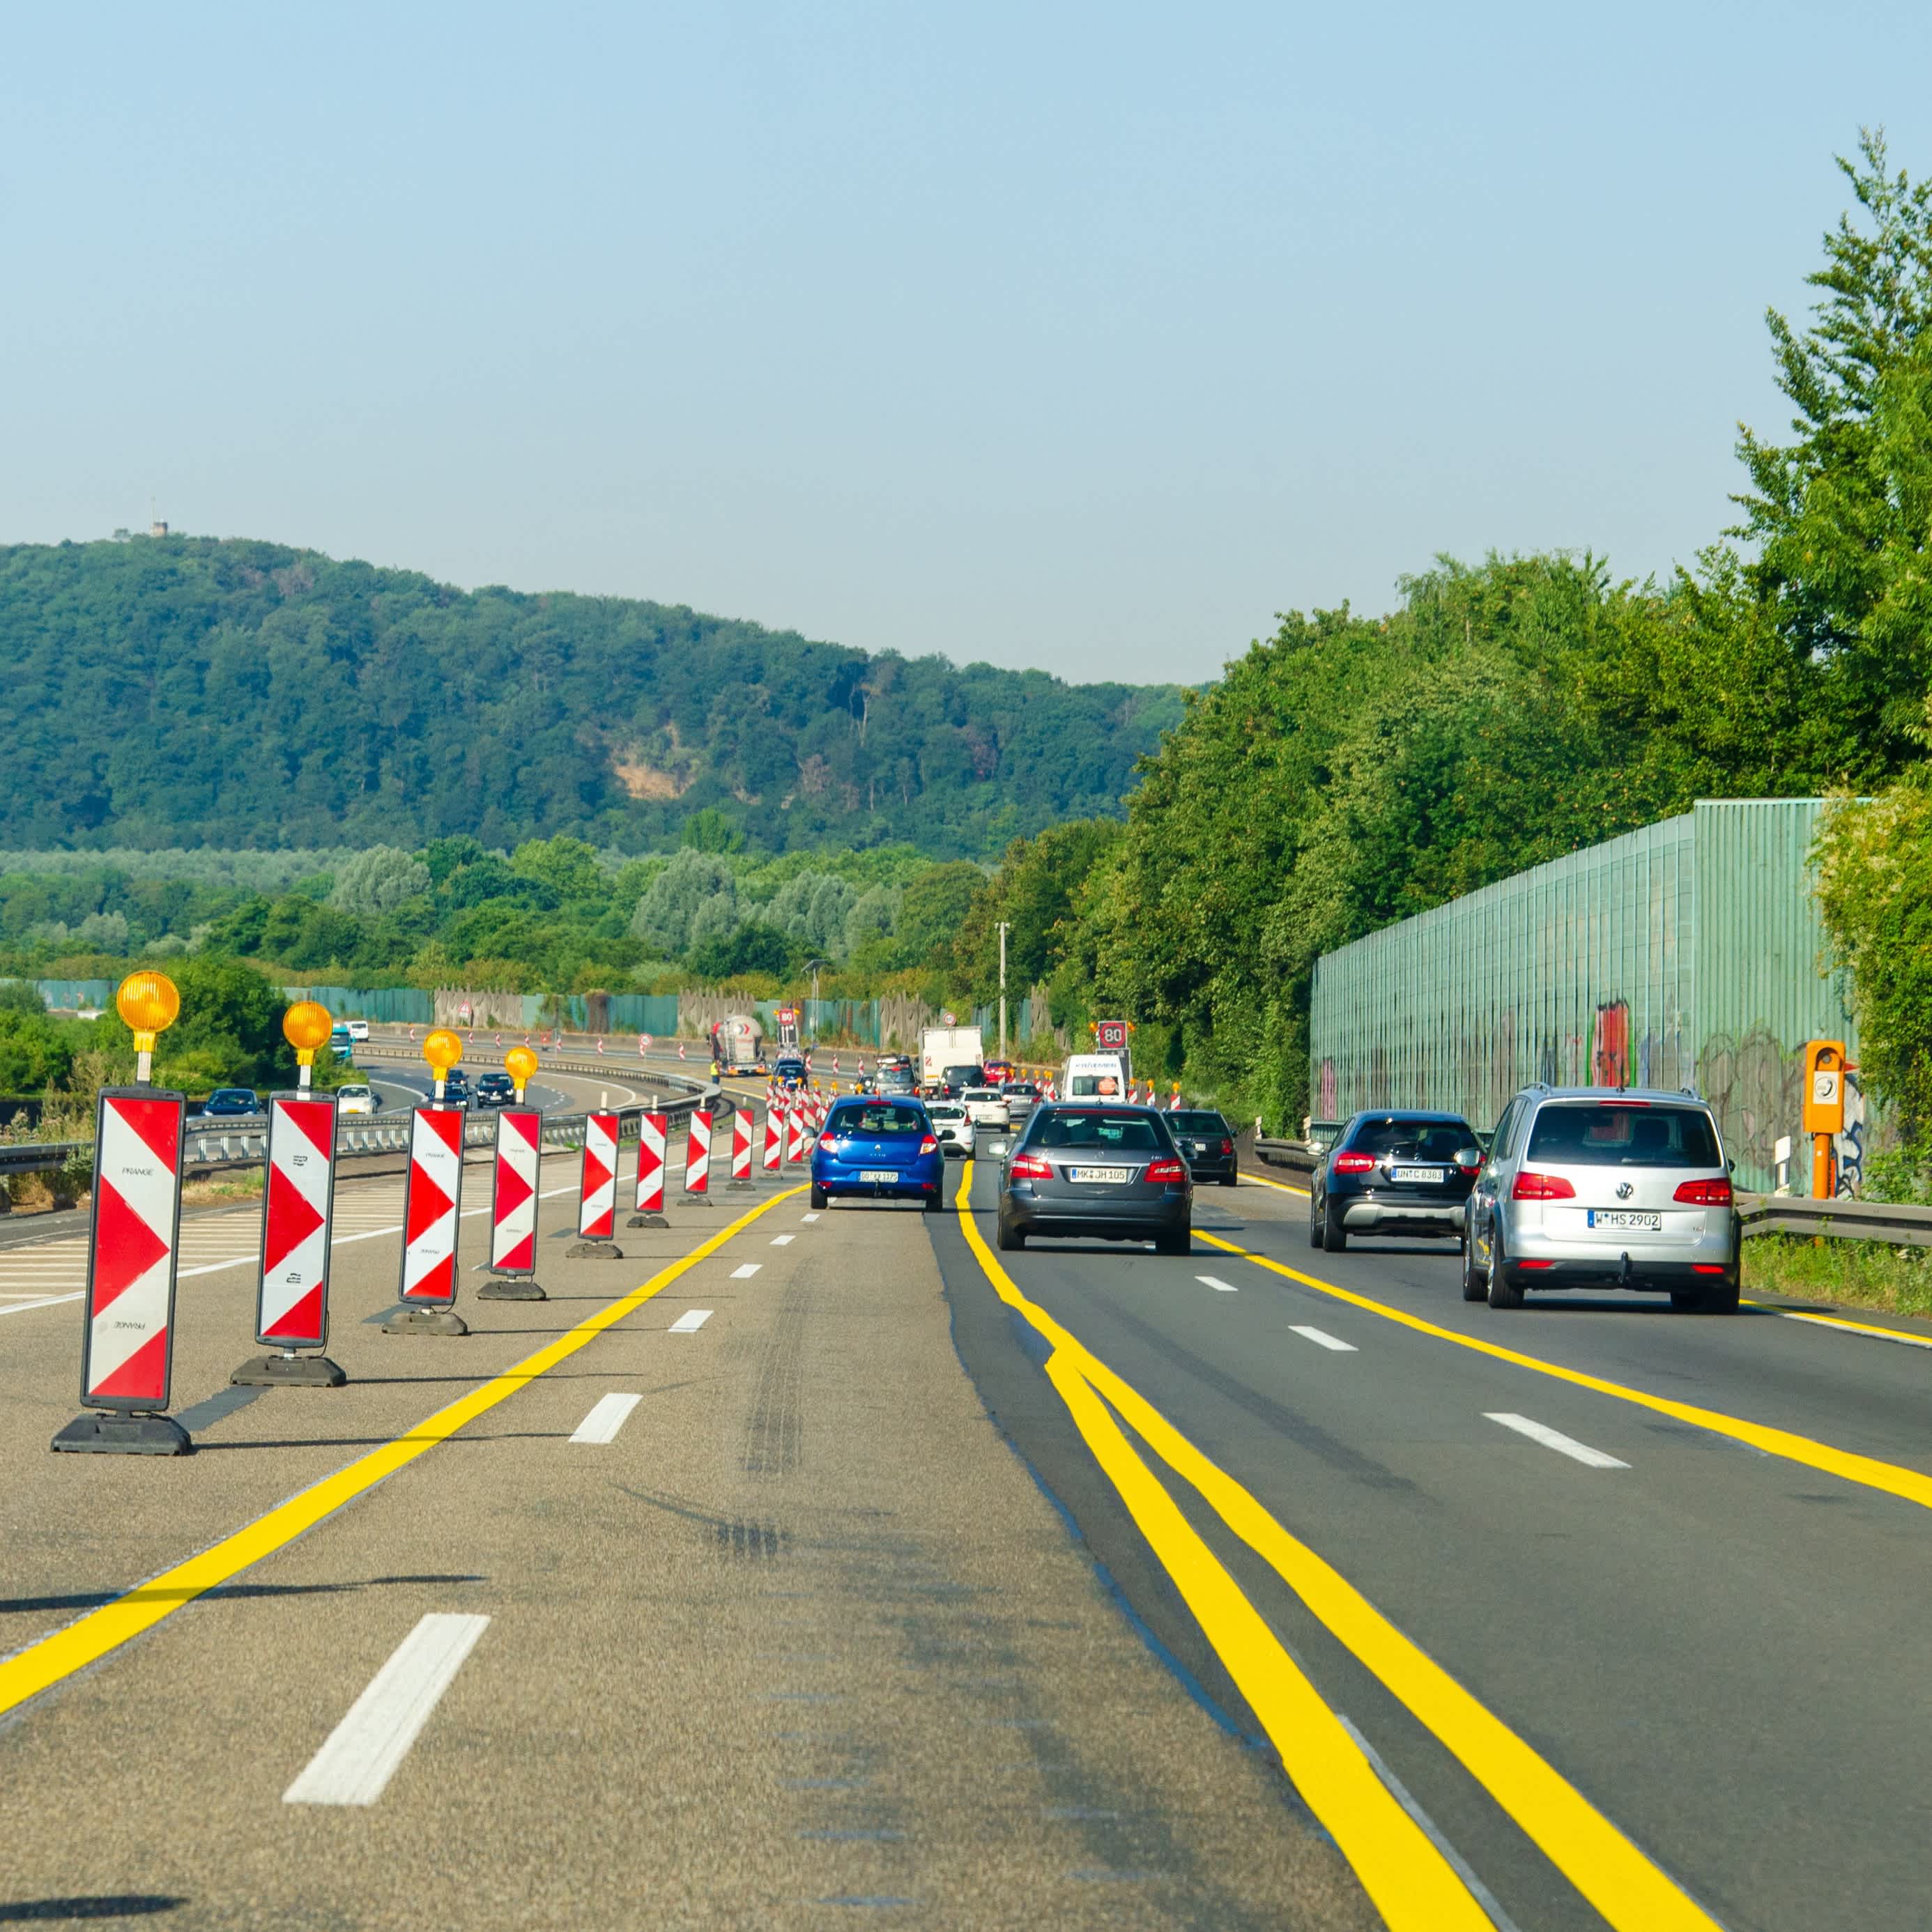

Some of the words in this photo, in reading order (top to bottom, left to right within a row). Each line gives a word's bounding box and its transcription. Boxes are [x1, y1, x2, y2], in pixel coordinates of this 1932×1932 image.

[1104, 1029, 1122, 1042] 80
[1077, 1170, 1089, 1179] MK
[1096, 1171, 1107, 1179] JH
[1108, 1171, 1125, 1179] 105
[1611, 1213, 1627, 1225] HS
[1629, 1214, 1659, 1227] 2902
